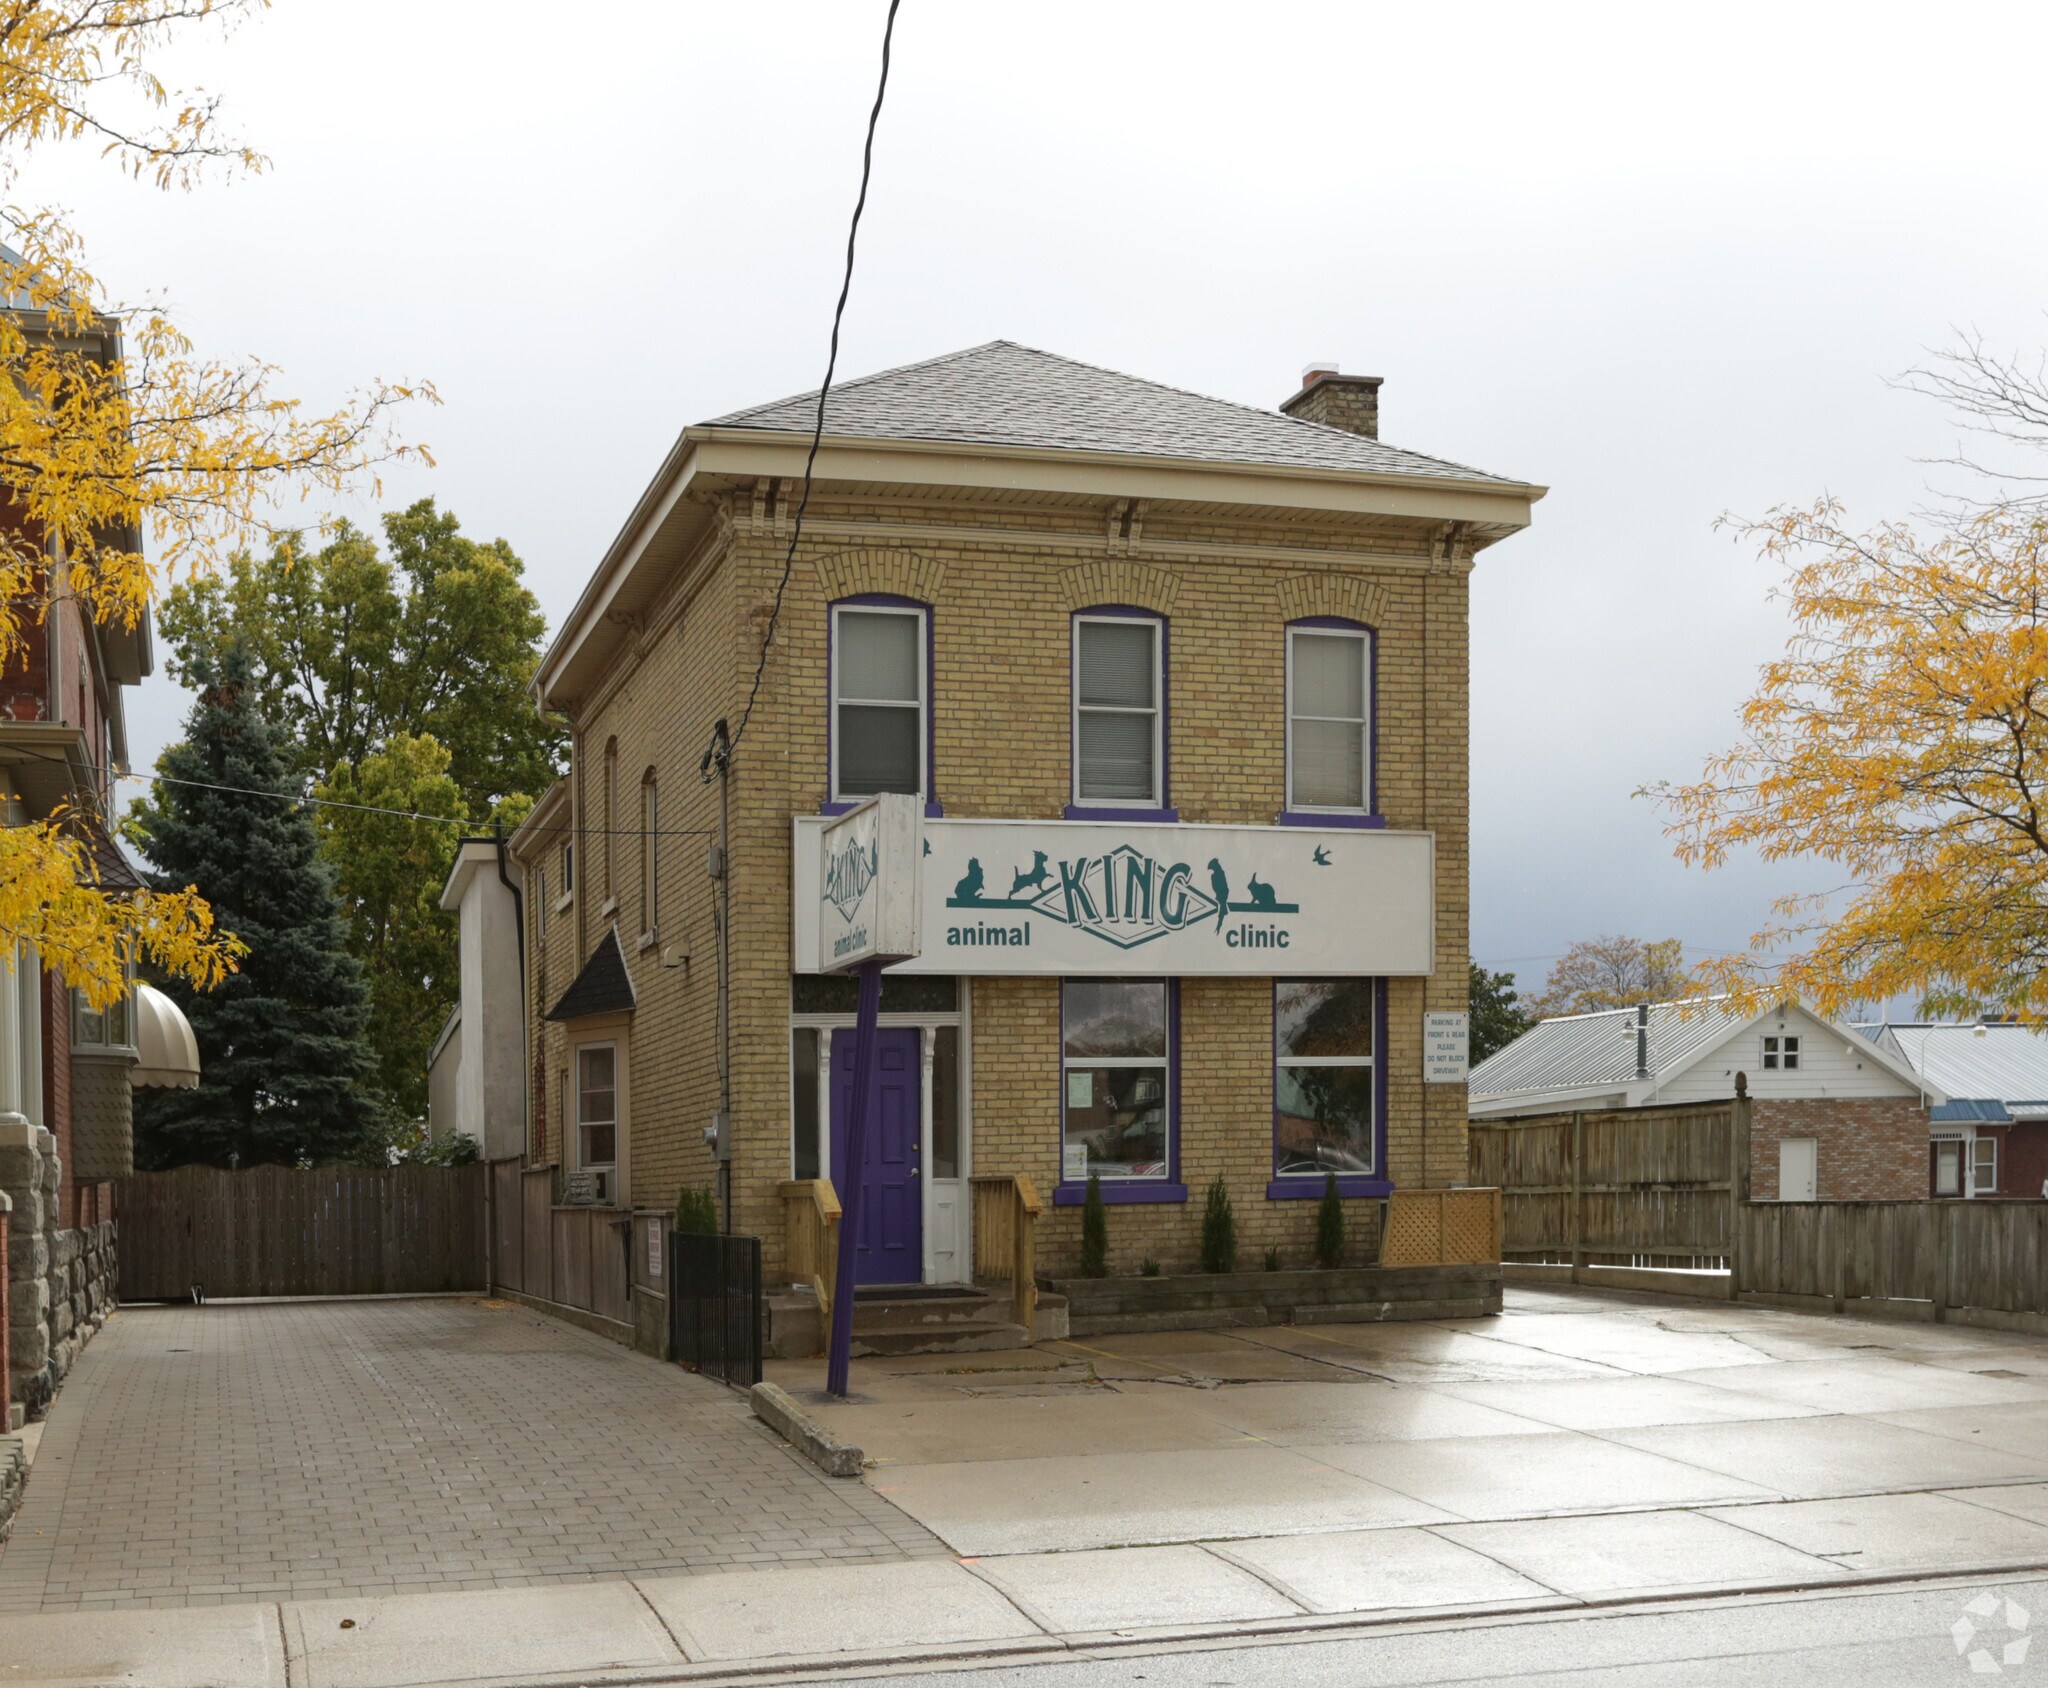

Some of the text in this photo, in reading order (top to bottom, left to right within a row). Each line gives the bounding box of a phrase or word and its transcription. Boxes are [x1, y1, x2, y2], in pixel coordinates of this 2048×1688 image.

[835, 845, 865, 904] KING
[1058, 853, 1194, 929] KING
[834, 923, 867, 957] animal clinic
[946, 921, 1290, 949] animal clinic
